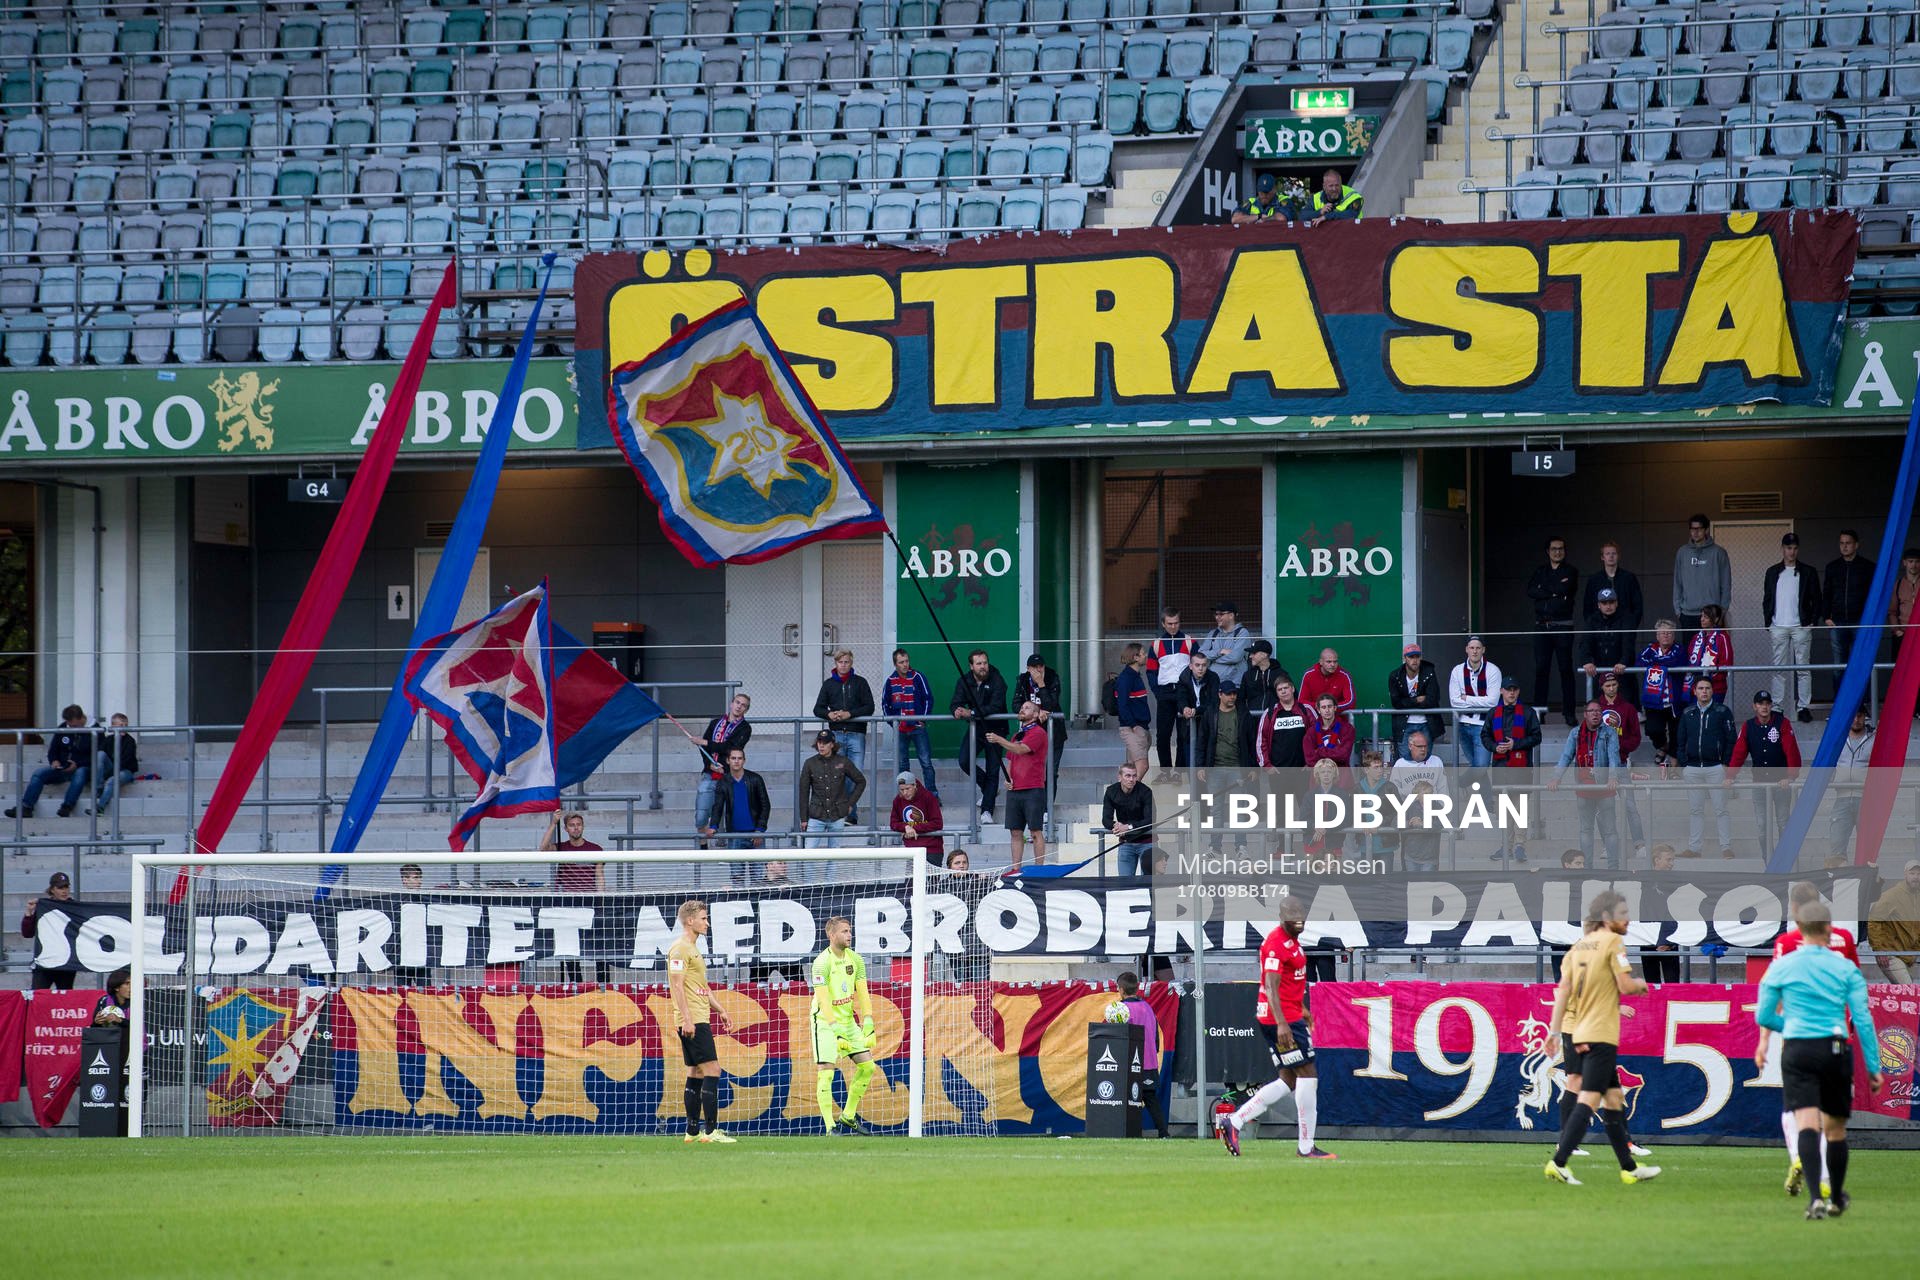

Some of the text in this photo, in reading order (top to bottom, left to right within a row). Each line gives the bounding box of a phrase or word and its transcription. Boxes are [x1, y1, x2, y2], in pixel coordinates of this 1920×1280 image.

[1250, 127, 1342, 154] ÅBRO
[1204, 168, 1238, 216] H4
[1388, 211, 1802, 390] STÅ
[0, 389, 206, 451] ÅBRO
[306, 481, 329, 497] G4
[901, 546, 1012, 580] ÅBRO
[1279, 544, 1393, 578] ÅBRO
[34, 900, 596, 975] SOLIDARITET
[629, 899, 816, 970] MED
[1209, 1027, 1255, 1037] Got Event
[88, 1067, 111, 1075] SELECT
[1095, 1063, 1119, 1072] SELECT
[1089, 1098, 1123, 1107] Volkswagen
